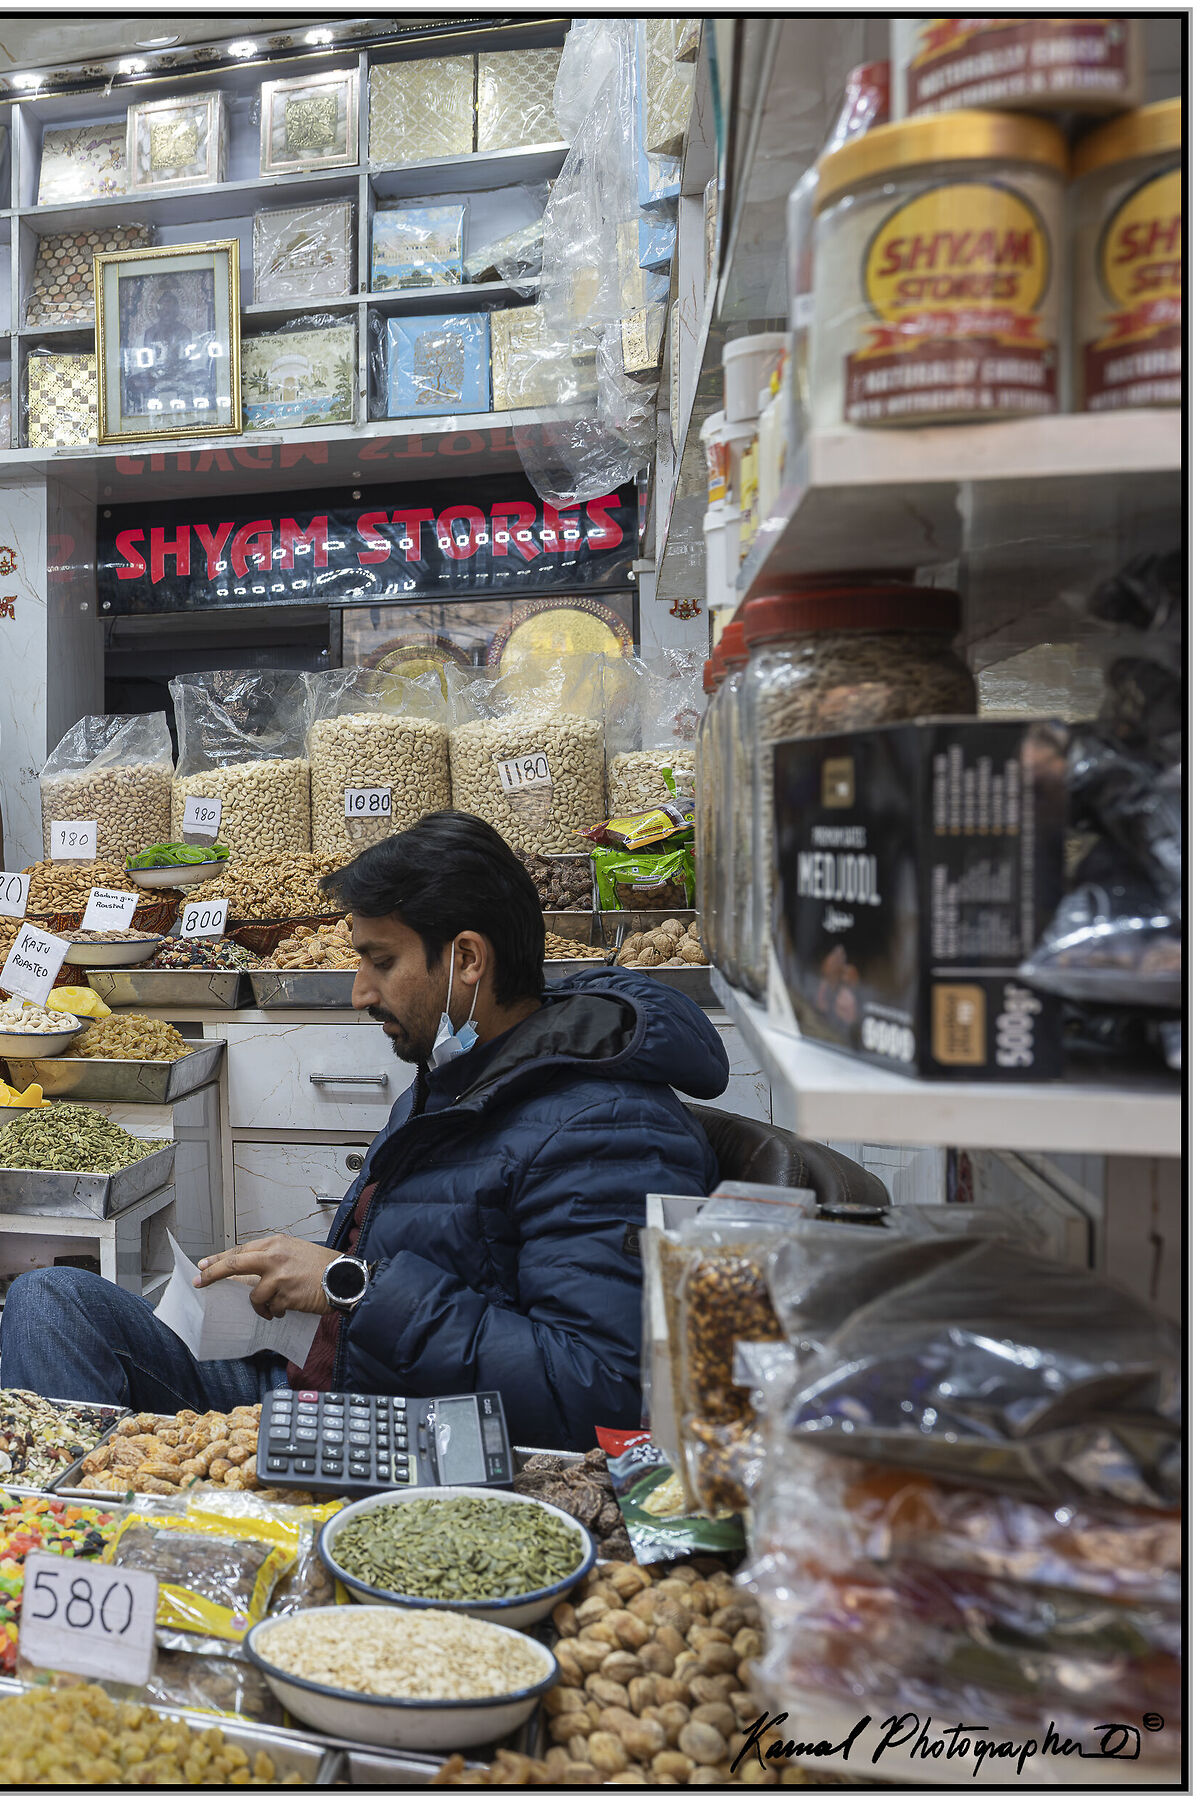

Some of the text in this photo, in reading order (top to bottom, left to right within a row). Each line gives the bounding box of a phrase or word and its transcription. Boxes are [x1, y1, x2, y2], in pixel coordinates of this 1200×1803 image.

[877, 227, 1035, 279] SHYAM
[891, 272, 1020, 308] STORES
[114, 494, 624, 585] SHYAM STORES
[504, 756, 548, 786] 1180
[194, 806, 216, 822] 980
[349, 793, 391, 812] 1080
[60, 830, 90, 847] 980
[797, 851, 882, 907] MEDJOOL
[185, 910, 223, 932] 800
[12, 953, 49, 978] ROASTED
